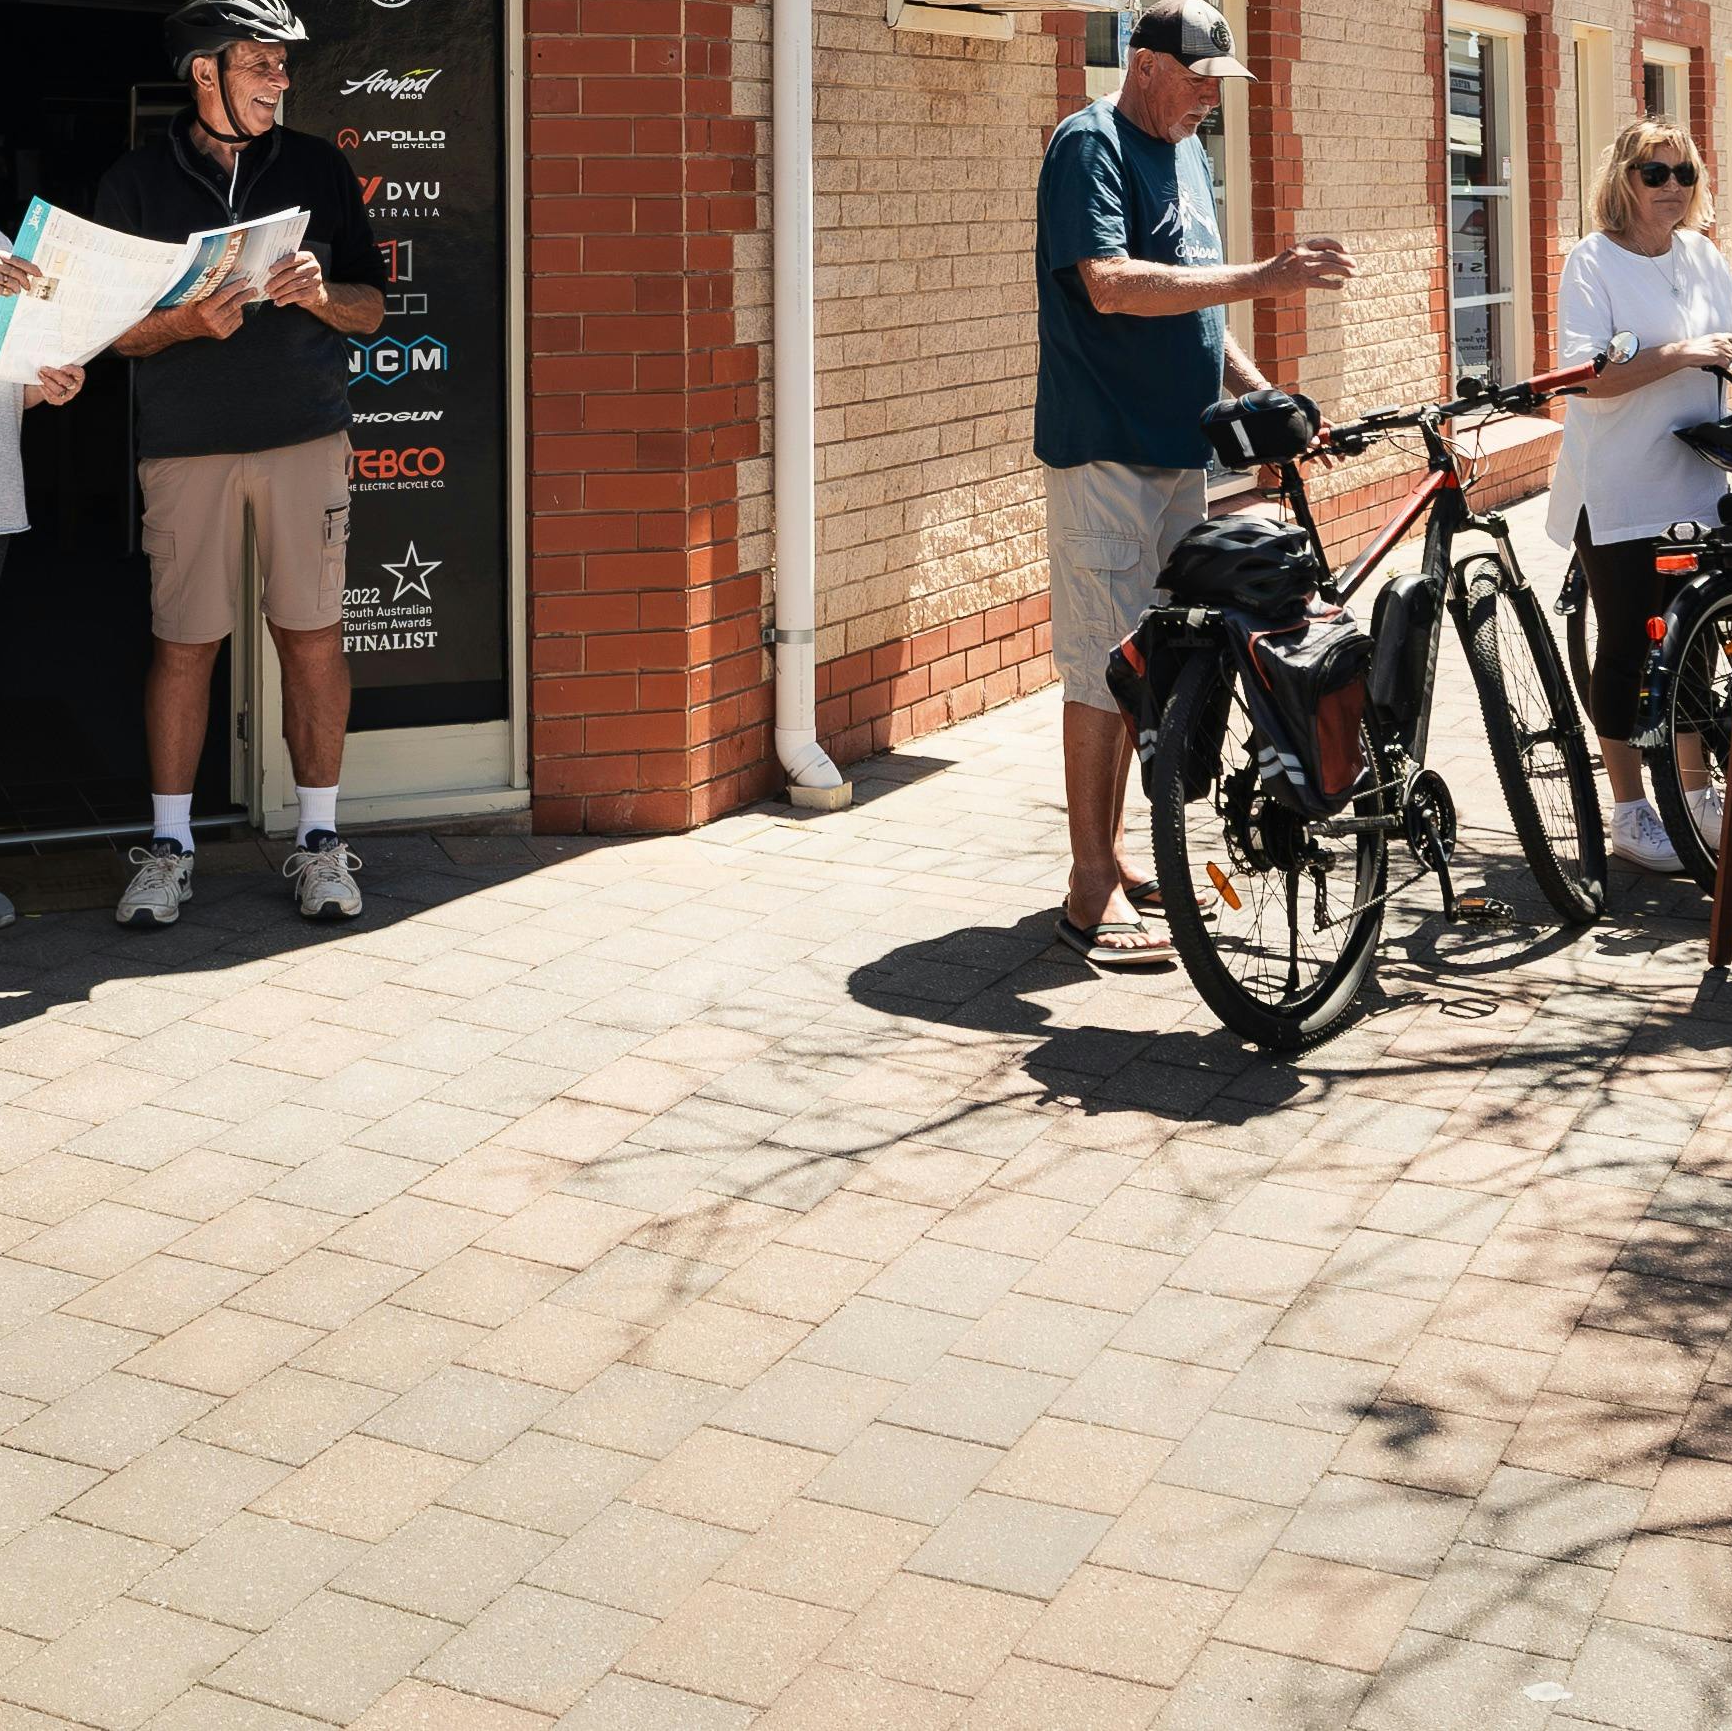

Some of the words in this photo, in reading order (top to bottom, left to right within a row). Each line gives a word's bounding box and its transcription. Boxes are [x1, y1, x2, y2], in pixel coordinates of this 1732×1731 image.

[340, 69, 442, 100] Ampd
[363, 130, 446, 142] APOLLO
[369, 208, 441, 218] STRALIA
[348, 484, 357, 492] HE
[359, 482, 395, 492] ELECTRIC
[397, 481, 429, 490] BICYCLE
[342, 587, 380, 605] 2022
[342, 606, 373, 619] South
[376, 603, 432, 617] Australian
[343, 619, 387, 631] Tourism
[390, 616, 432, 628] Awards
[342, 630, 438, 653] FINALIST
